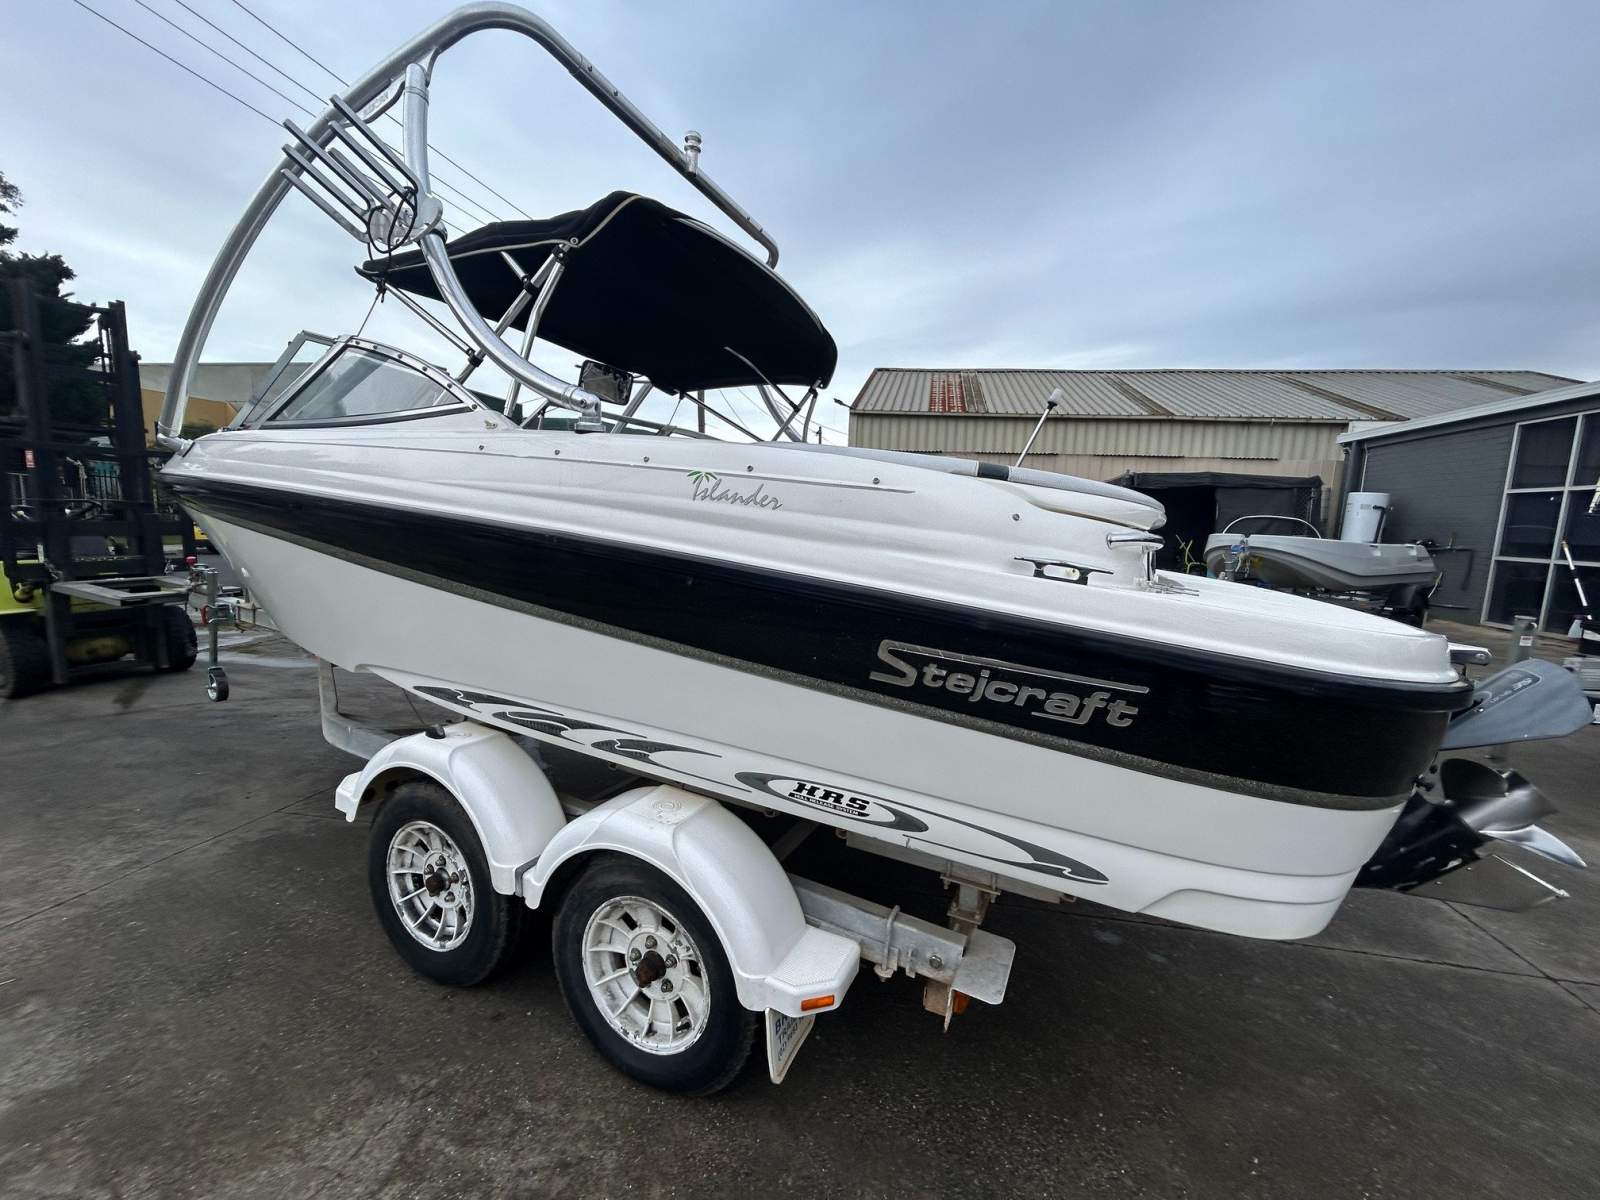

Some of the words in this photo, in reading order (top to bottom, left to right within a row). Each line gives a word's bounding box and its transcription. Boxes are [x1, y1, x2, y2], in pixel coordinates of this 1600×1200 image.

[692, 475, 782, 510] Islander
[869, 639, 1149, 727] Stejcraft
[793, 782, 870, 811] HRS
